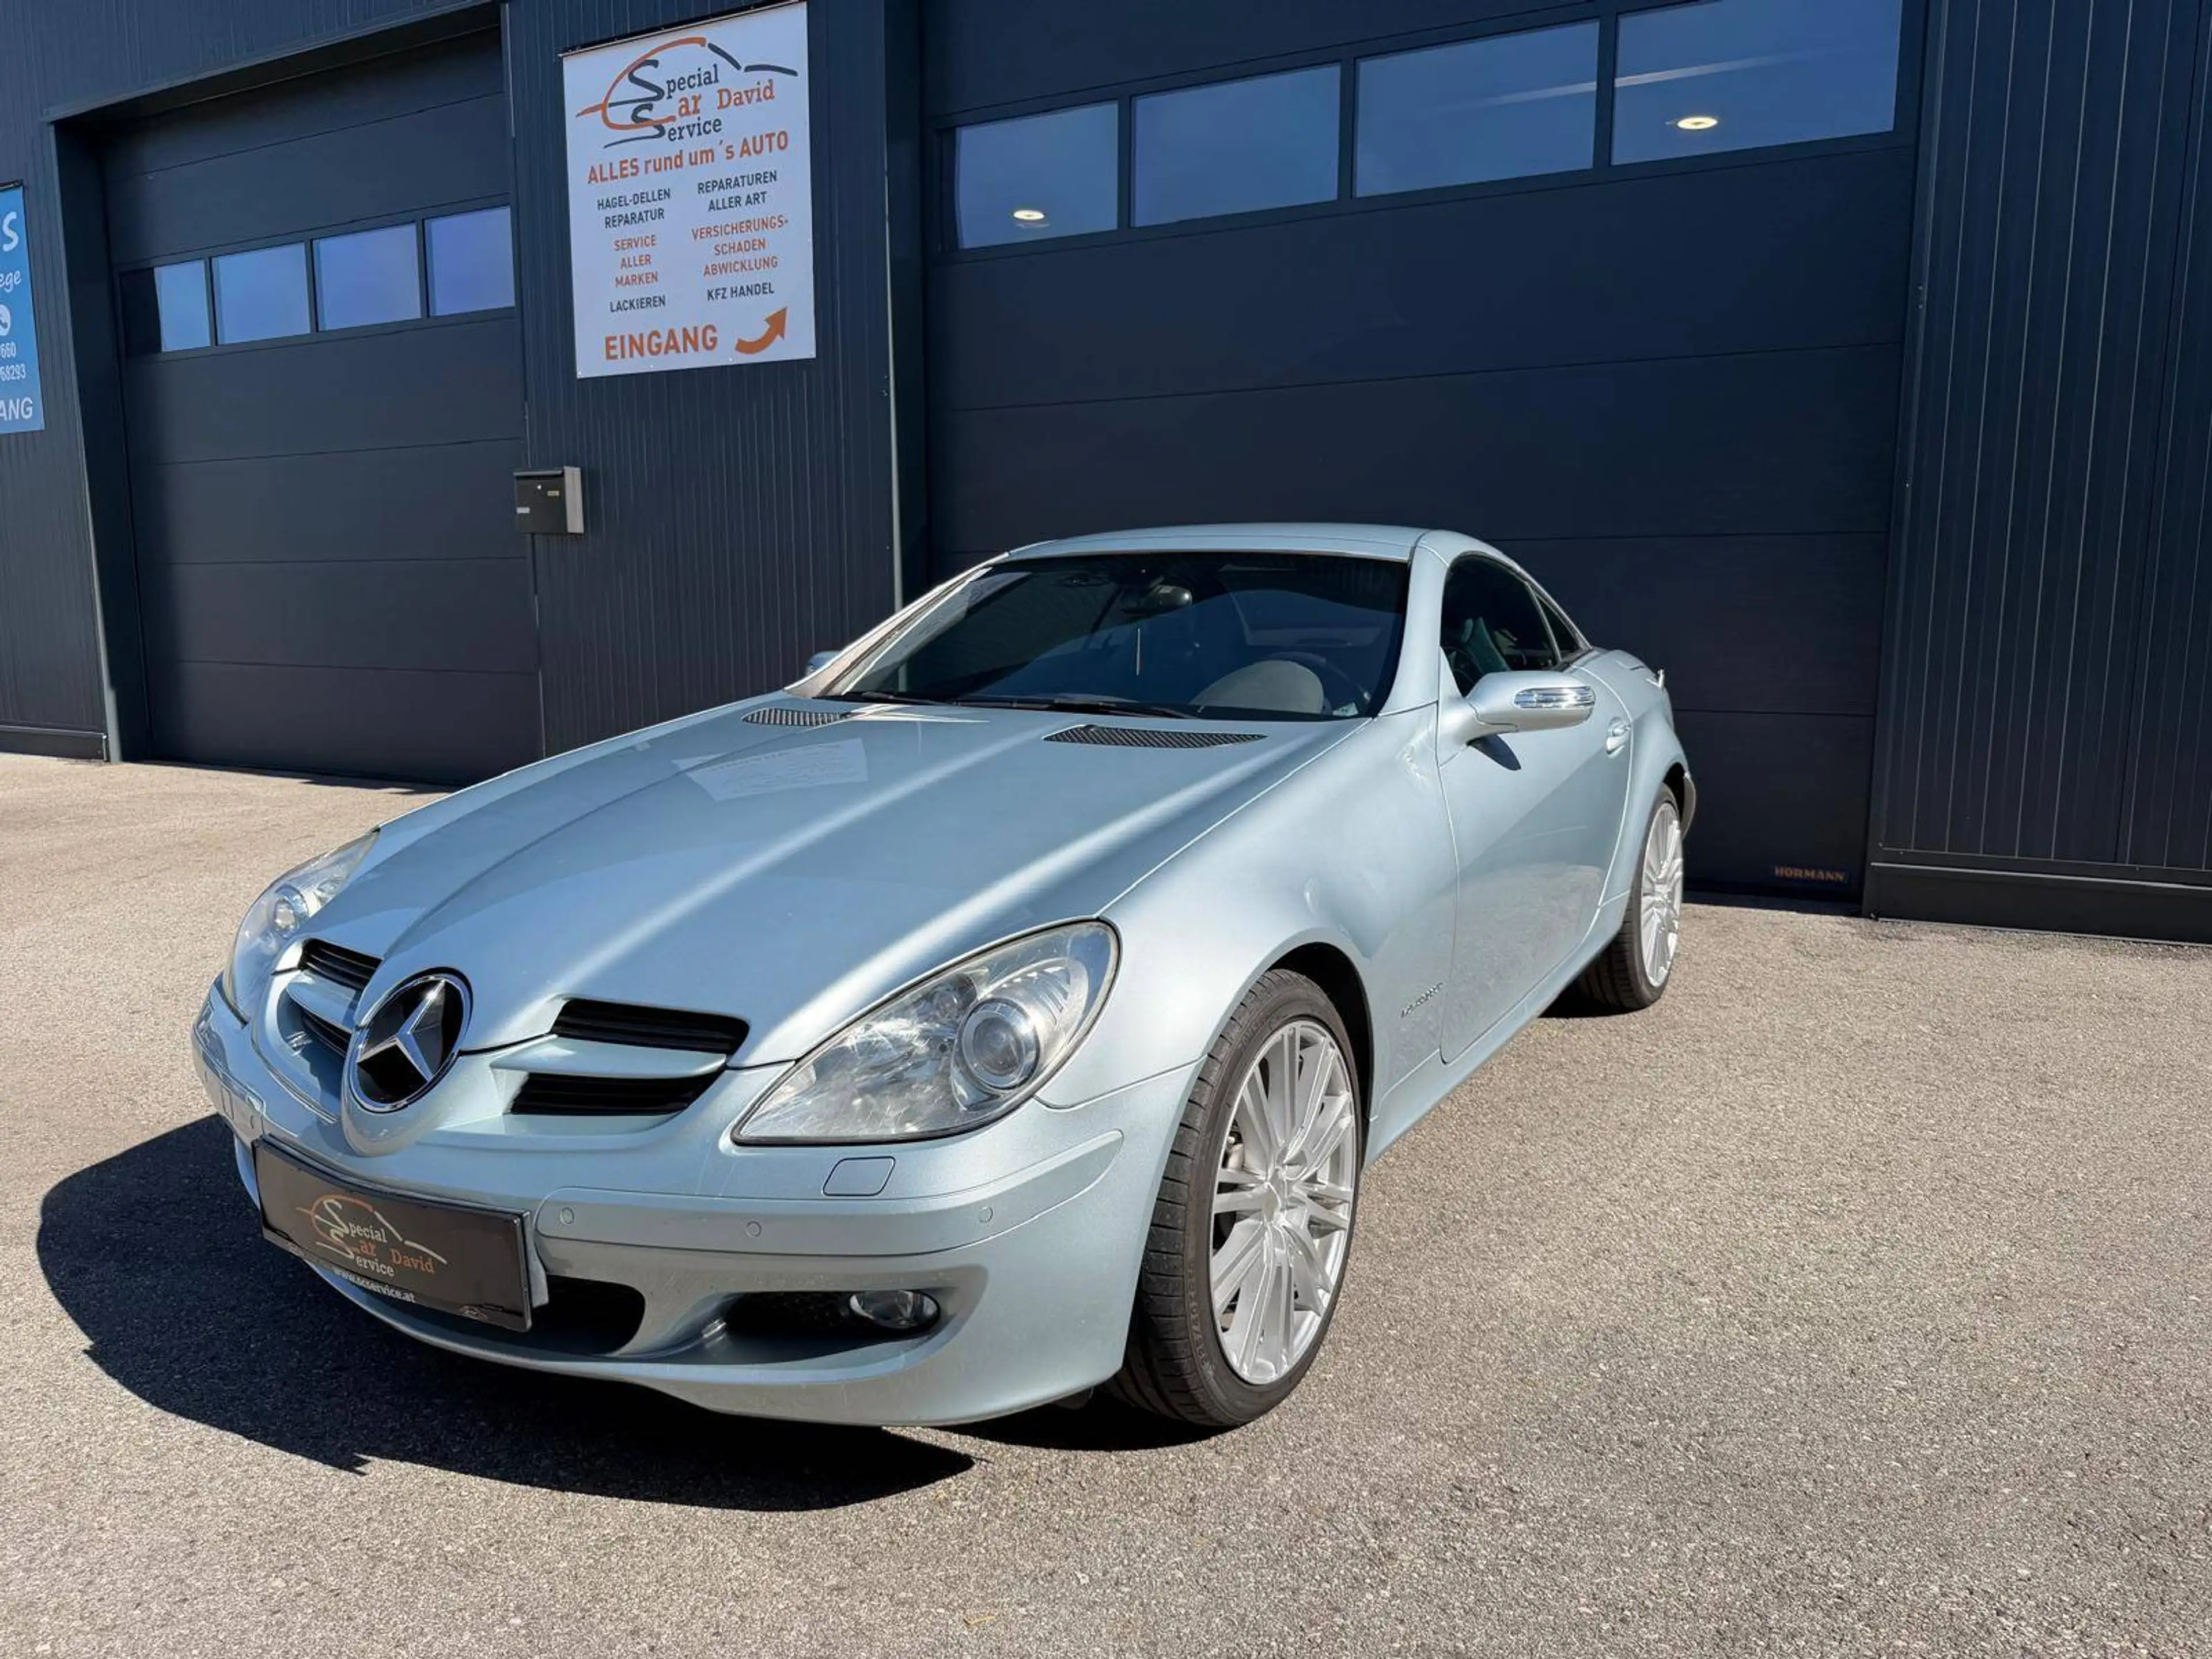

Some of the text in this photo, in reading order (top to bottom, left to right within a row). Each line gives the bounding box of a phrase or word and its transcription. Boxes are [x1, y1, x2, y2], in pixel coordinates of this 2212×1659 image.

[609, 59, 719, 107] Special
[717, 78, 775, 111] David
[588, 157, 639, 184] ALLES
[643, 150, 683, 175] rund
[688, 148, 715, 166] um
[740, 131, 789, 158] AUTO
[698, 171, 777, 195] REPARATUREN
[597, 188, 671, 211] HAGEL-DELLEN
[708, 191, 768, 212] ALLER ART
[604, 208, 665, 229] REPARATUR
[691, 214, 789, 241] VERSICHERUNGS-
[2, 211, 19, 252] S
[613, 235, 657, 252] SERVICE
[714, 238, 767, 256] SCHADEN
[620, 255, 652, 271] ALLER
[703, 256, 779, 277] ABWICKLUNG
[615, 271, 658, 288] MARKEN
[707, 282, 775, 301] KFZ HANDEL
[609, 294, 666, 313] LACKIEREN
[604, 324, 718, 361] EINGANG
[315, 1198, 388, 1243] Special
[389, 1247, 435, 1274] David
